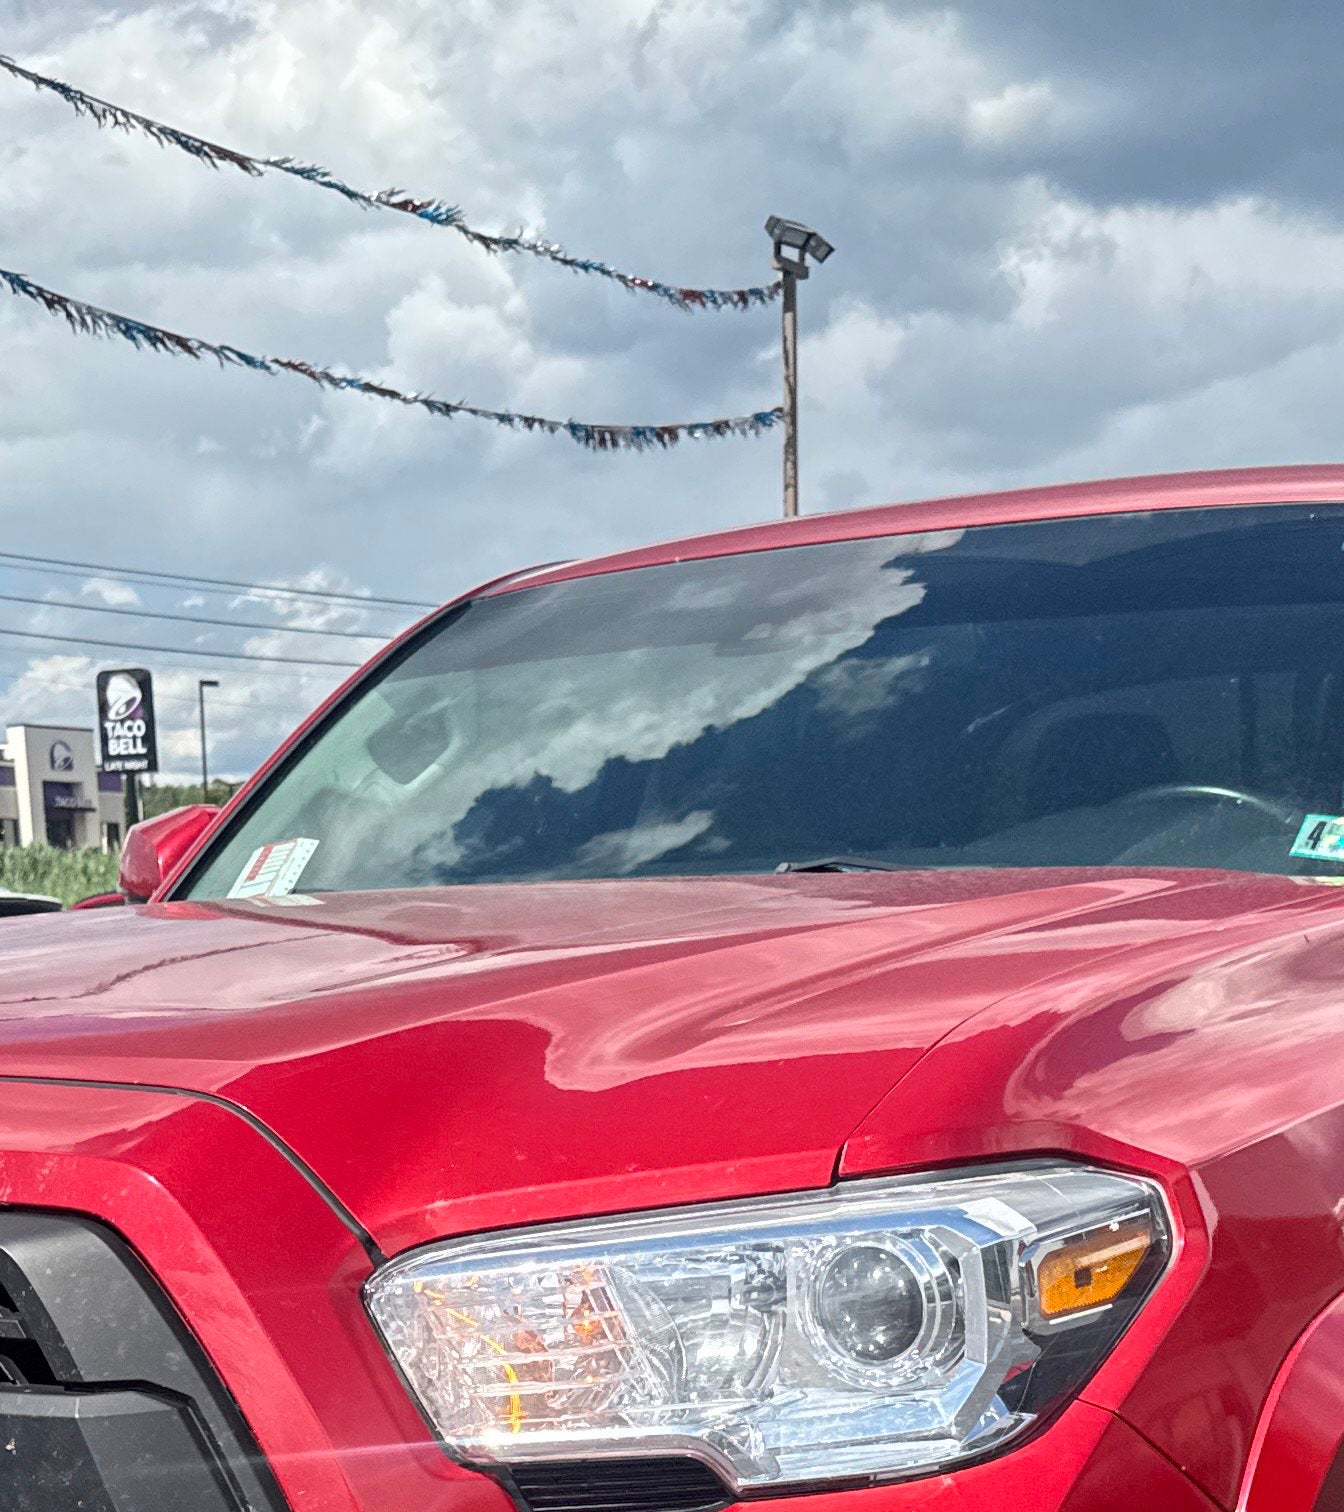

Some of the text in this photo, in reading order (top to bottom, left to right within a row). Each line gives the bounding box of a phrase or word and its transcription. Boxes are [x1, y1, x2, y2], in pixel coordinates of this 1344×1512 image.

[104, 719, 146, 738] TACO
[108, 737, 147, 755] BELL
[1307, 821, 1327, 850] 4
